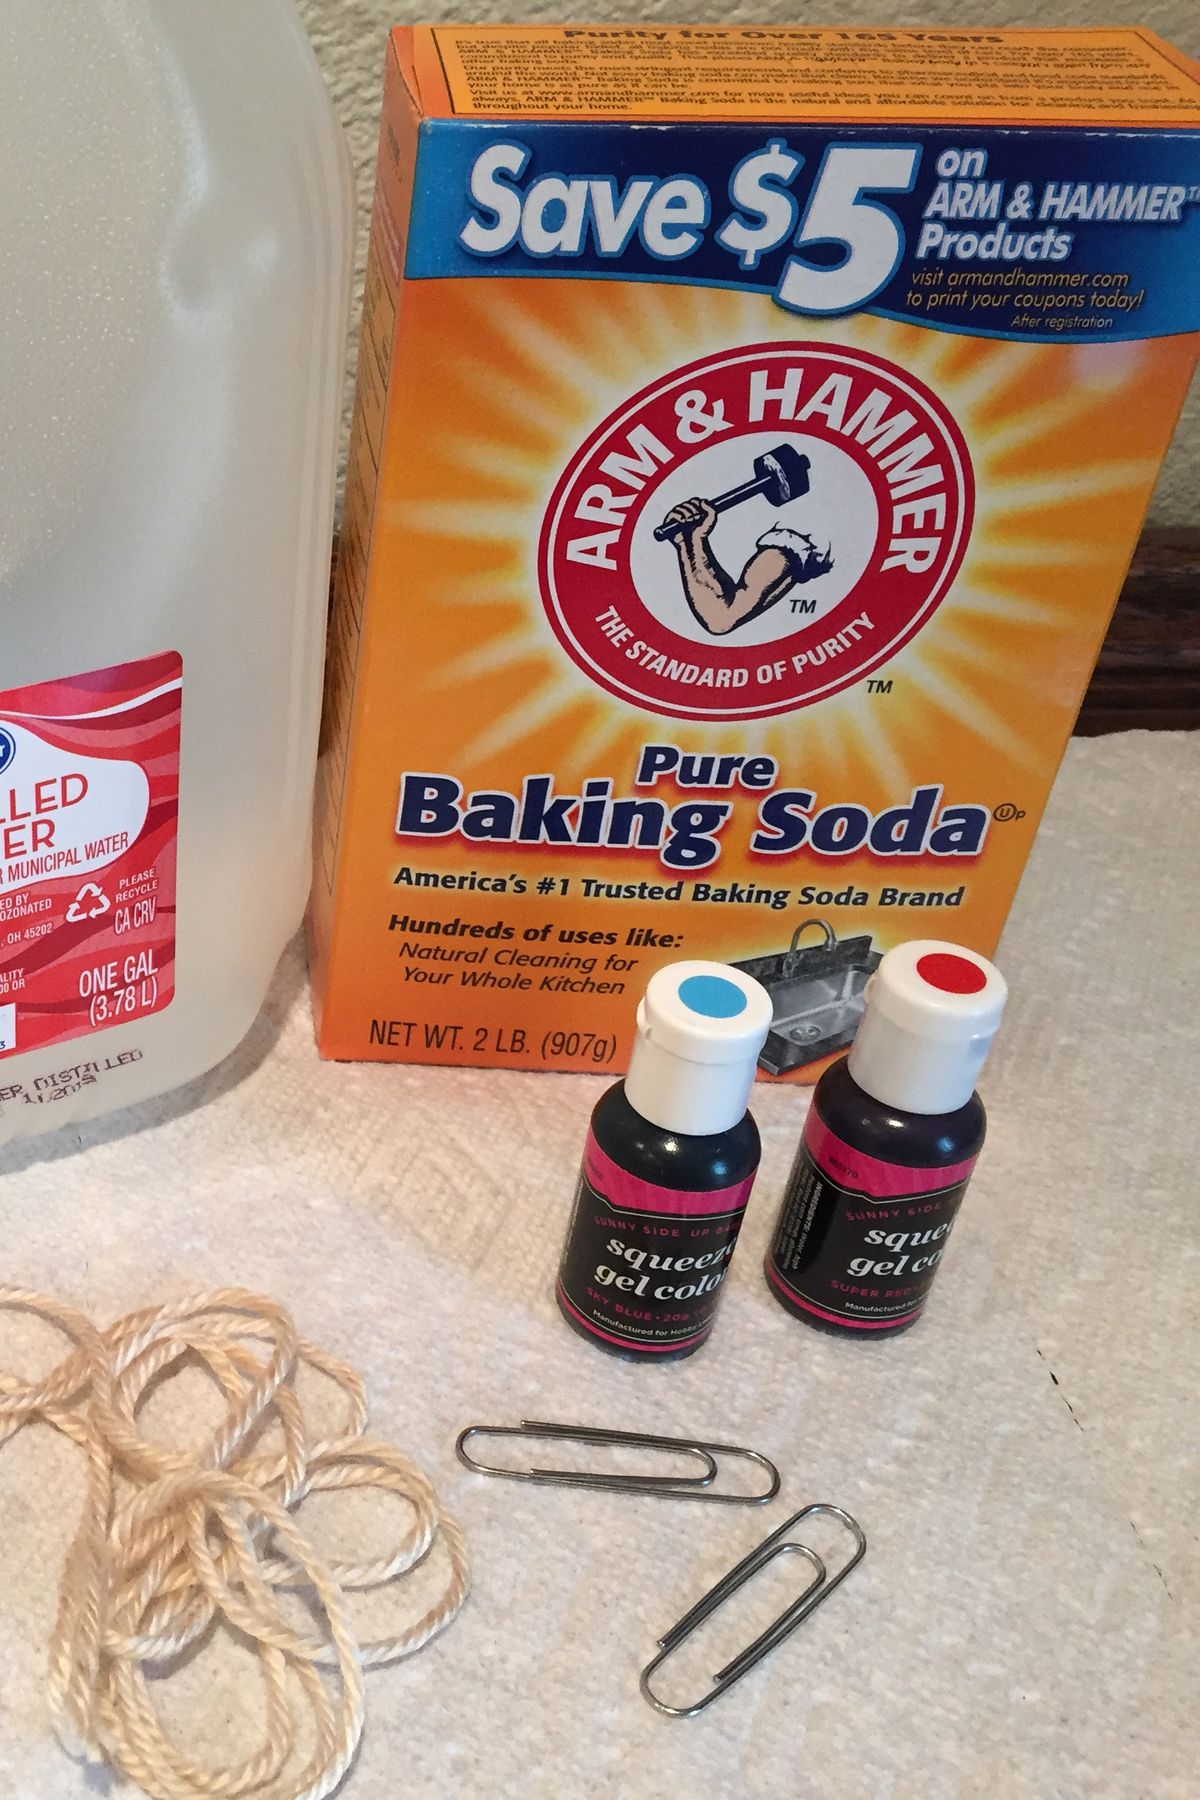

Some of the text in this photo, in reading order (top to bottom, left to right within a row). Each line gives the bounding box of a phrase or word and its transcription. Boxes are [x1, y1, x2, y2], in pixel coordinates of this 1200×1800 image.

[564, 30, 1004, 43] Purity for Over 165 Years
[473, 103, 550, 111] throughout
[936, 148, 988, 178] on
[923, 180, 1001, 219] ARM
[1006, 184, 1032, 221] &
[458, 141, 921, 312] Save $5
[915, 222, 1072, 261] Products
[911, 267, 1129, 288] visit armandhammer.com
[906, 287, 1145, 312] to print your coupons today!
[1011, 315, 1113, 331] After registration
[565, 367, 948, 575] ARM & HAMMER
[594, 605, 876, 688] THE STANDARD OF PURITY
[638, 744, 776, 790] Pure
[396, 772, 990, 869] Baking Soda
[8, 852, 81, 882] MUNICIPAL
[84, 831, 130, 860] WATER
[115, 879, 158, 904] RECYCLE
[119, 867, 156, 890] PLEASE
[536, 875, 570, 896] #1
[582, 877, 682, 902] Trusted
[691, 882, 791, 910] Baking
[798, 886, 872, 908] Soda
[878, 886, 966, 908] Brand
[0, 898, 52, 920] OZONATED
[15, 892, 29, 907] BY
[115, 896, 157, 935] CA CRV
[6, 933, 21, 945] OH
[24, 923, 52, 940] 45202
[388, 914, 684, 949] Hundreds of uses like:
[399, 941, 639, 974] Natural Cleaning for
[12, 978, 25, 990] OR
[79, 948, 159, 998] ONE GAL
[402, 966, 626, 996] Your Whole Kitchen
[90, 975, 158, 1026] (3.78 L)
[369, 1021, 618, 1063] NET WT. 2 LB. (907g)
[846, 1201, 942, 1221] SUNNY SIDE
[593, 1215, 710, 1238] SUNNY SIDE UP
[847, 1254, 910, 1277] gel
[594, 1264, 650, 1297] gel
[830, 1279, 880, 1298] SUPER
[884, 1287, 913, 1298] RED
[585, 1286, 609, 1306] SKY
[845, 1301, 907, 1313] Manufactured
[592, 1309, 654, 1336] Manufactured
[655, 1329, 668, 1337] for
